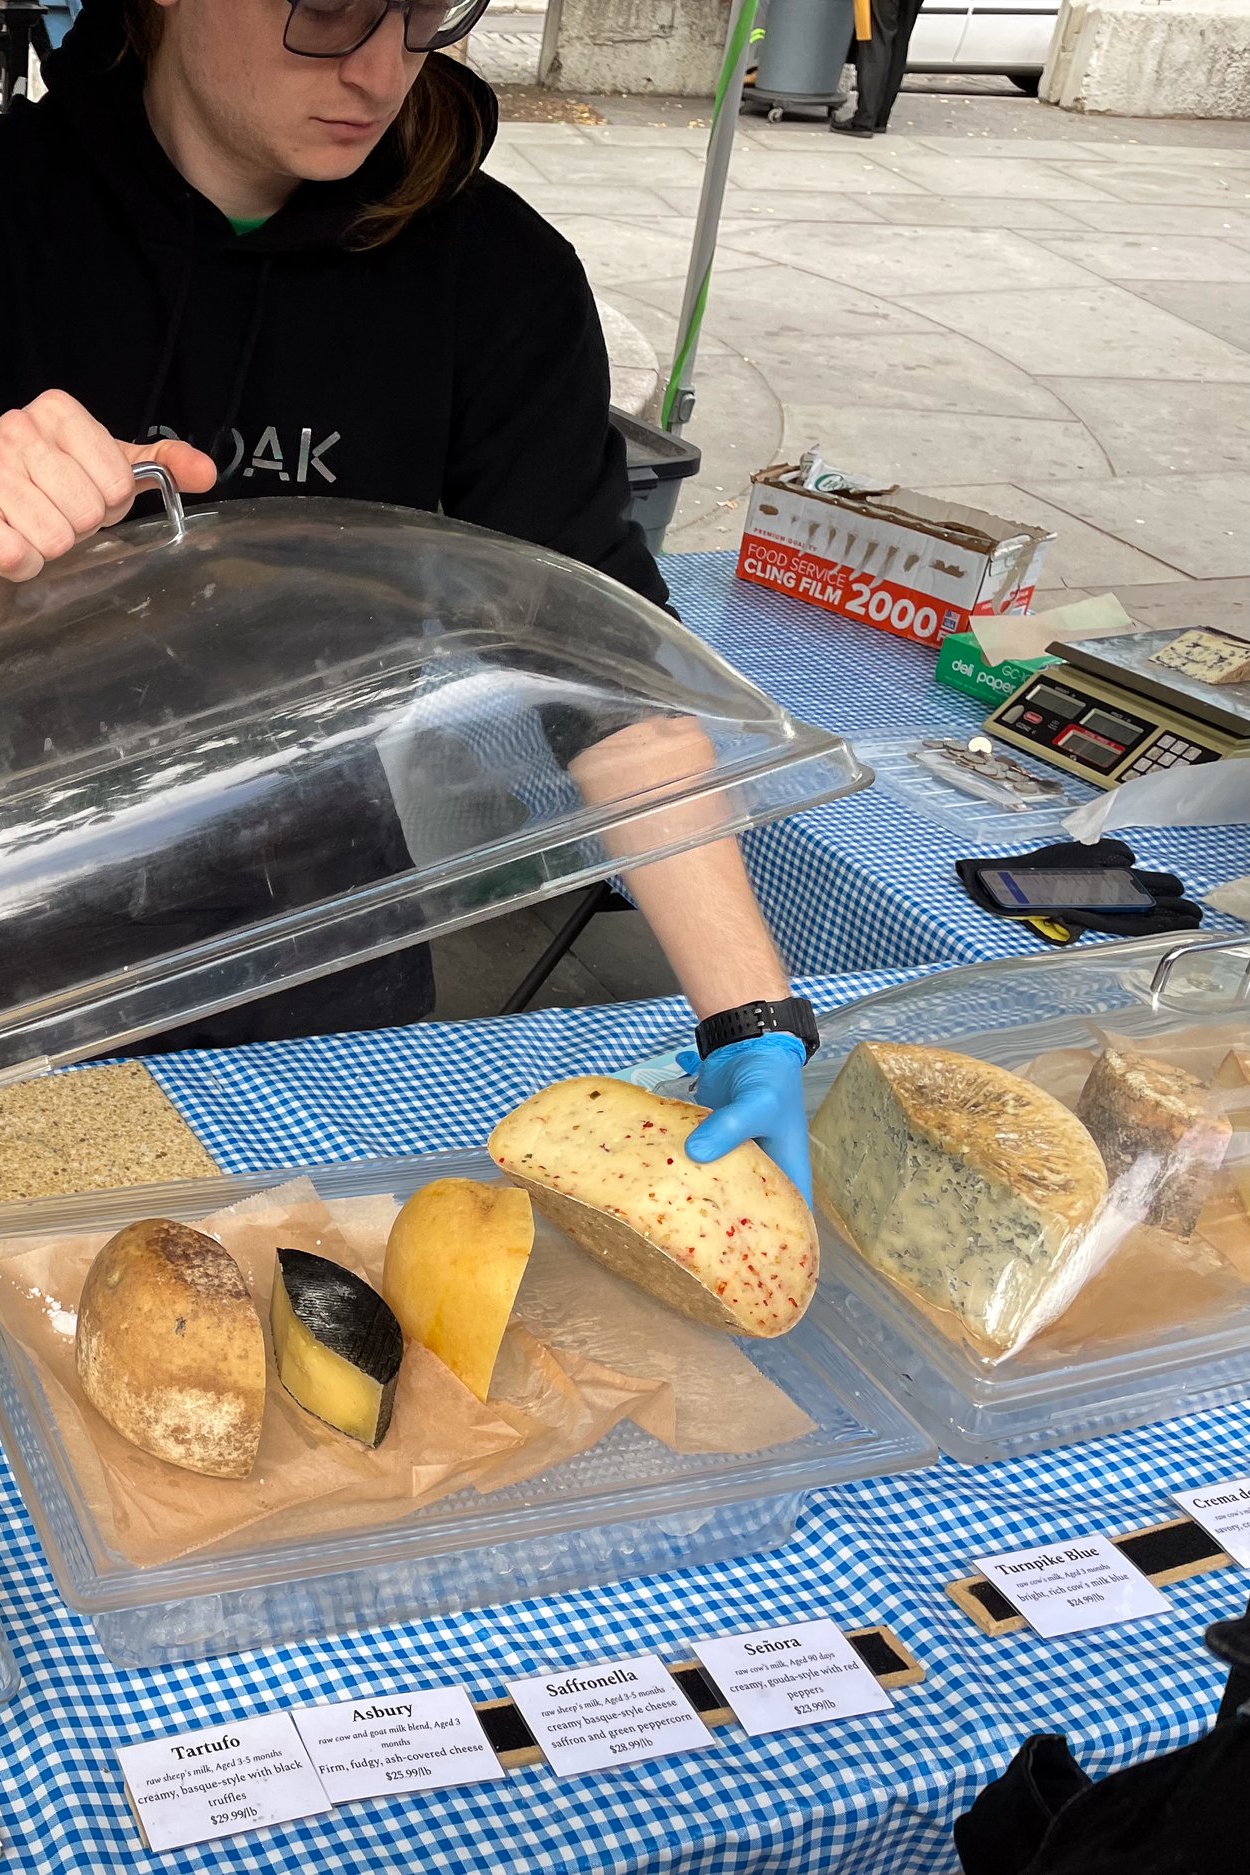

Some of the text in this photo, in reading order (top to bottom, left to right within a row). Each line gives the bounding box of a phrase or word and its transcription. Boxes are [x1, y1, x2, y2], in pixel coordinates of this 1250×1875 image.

[787, 538, 817, 552] QUALTY
[747, 543, 847, 588] FOOD SERVICE
[744, 557, 843, 606] CLING FILM
[844, 582, 938, 638] 2000
[951, 659, 1016, 694] deli paper
[1192, 1494, 1240, 1509] Crema
[994, 1547, 1100, 1576] Turnpike Blue
[1029, 1577, 1048, 1586] cow's
[1064, 1569, 1082, 1579] Aged
[1087, 1563, 1111, 1573] months
[1017, 1590, 1050, 1602] bright,
[1048, 1586, 1067, 1597] rich
[1090, 1576, 1111, 1588] milk
[1110, 1573, 1130, 1583] blue
[1067, 1592, 1105, 1608] $24.99/lb
[743, 1636, 803, 1656] Señora
[729, 1661, 860, 1693] creamy, gouda-style with red
[734, 1651, 836, 1676] raw cow's milk, Aged 90 days
[546, 1669, 638, 1697] Saffronella
[786, 1686, 824, 1701] peppers
[351, 1703, 413, 1722] Asbury
[541, 1686, 666, 1718] raw sheep's milk, Aged 3-5 months
[547, 1698, 678, 1733] creamy basque-style cheese
[794, 1699, 836, 1715] $23.99/lb
[318, 1717, 461, 1745] raw cow and goat milk blend, Aged 3
[381, 1738, 411, 1749] months
[551, 1713, 693, 1749] saffron and green peppercorn
[170, 1734, 241, 1761] Tartufo
[318, 1743, 485, 1775] Firm, fudgy, ash-covered cheese
[609, 1738, 654, 1755] $28.99/lb
[146, 1749, 283, 1786] raw sheep's milk, Aged 3-5 months
[385, 1766, 432, 1782] $25.99/lb
[137, 1759, 303, 1805] creamy, basque-style with black
[207, 1791, 248, 1808] truffles
[209, 1806, 258, 1826] $29.99/lb
